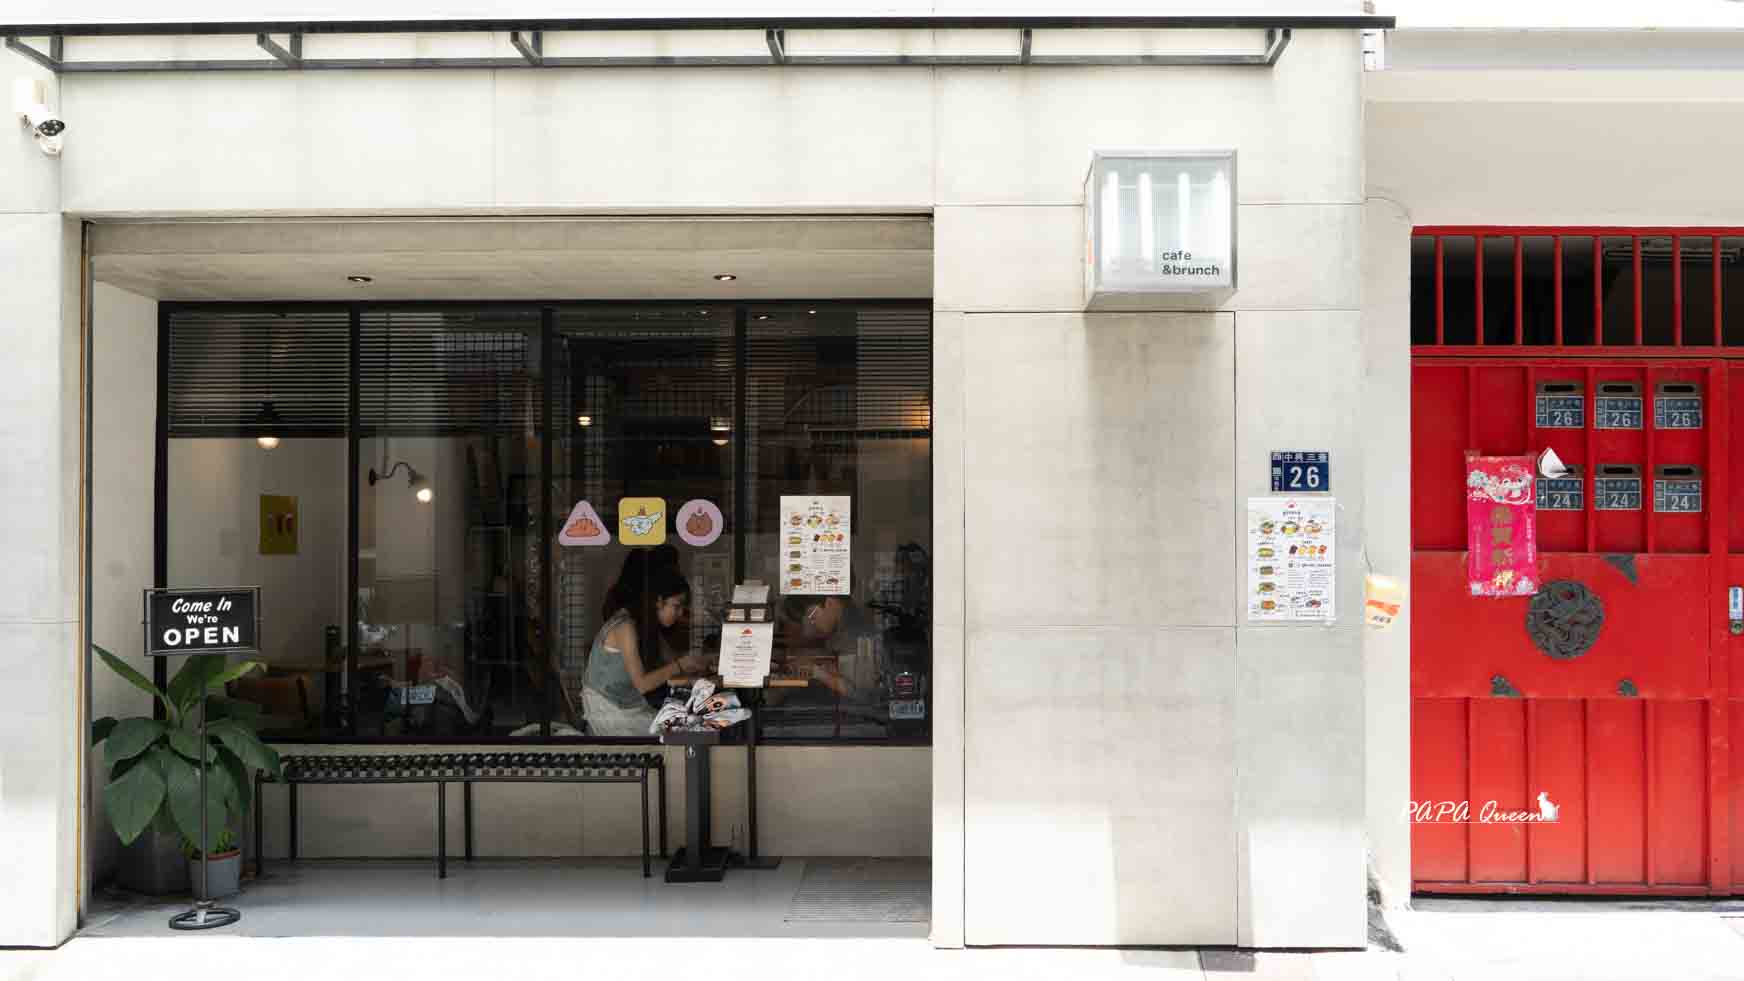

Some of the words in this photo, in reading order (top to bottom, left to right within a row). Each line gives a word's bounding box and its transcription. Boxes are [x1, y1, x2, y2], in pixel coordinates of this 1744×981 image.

[1162, 250, 1192, 261] cafe
[1162, 264, 1220, 276] &brunch
[1552, 411, 1573, 426] 26
[1611, 412, 1632, 427] 26
[1671, 412, 1691, 427] 26
[1290, 466, 1320, 488] 26
[1552, 494, 1571, 508] 24
[1610, 494, 1629, 508] 24
[1671, 495, 1690, 510] 24
[171, 598, 213, 614] Come
[216, 596, 232, 612] In
[186, 614, 218, 625] We're
[163, 626, 240, 646] OPEN
